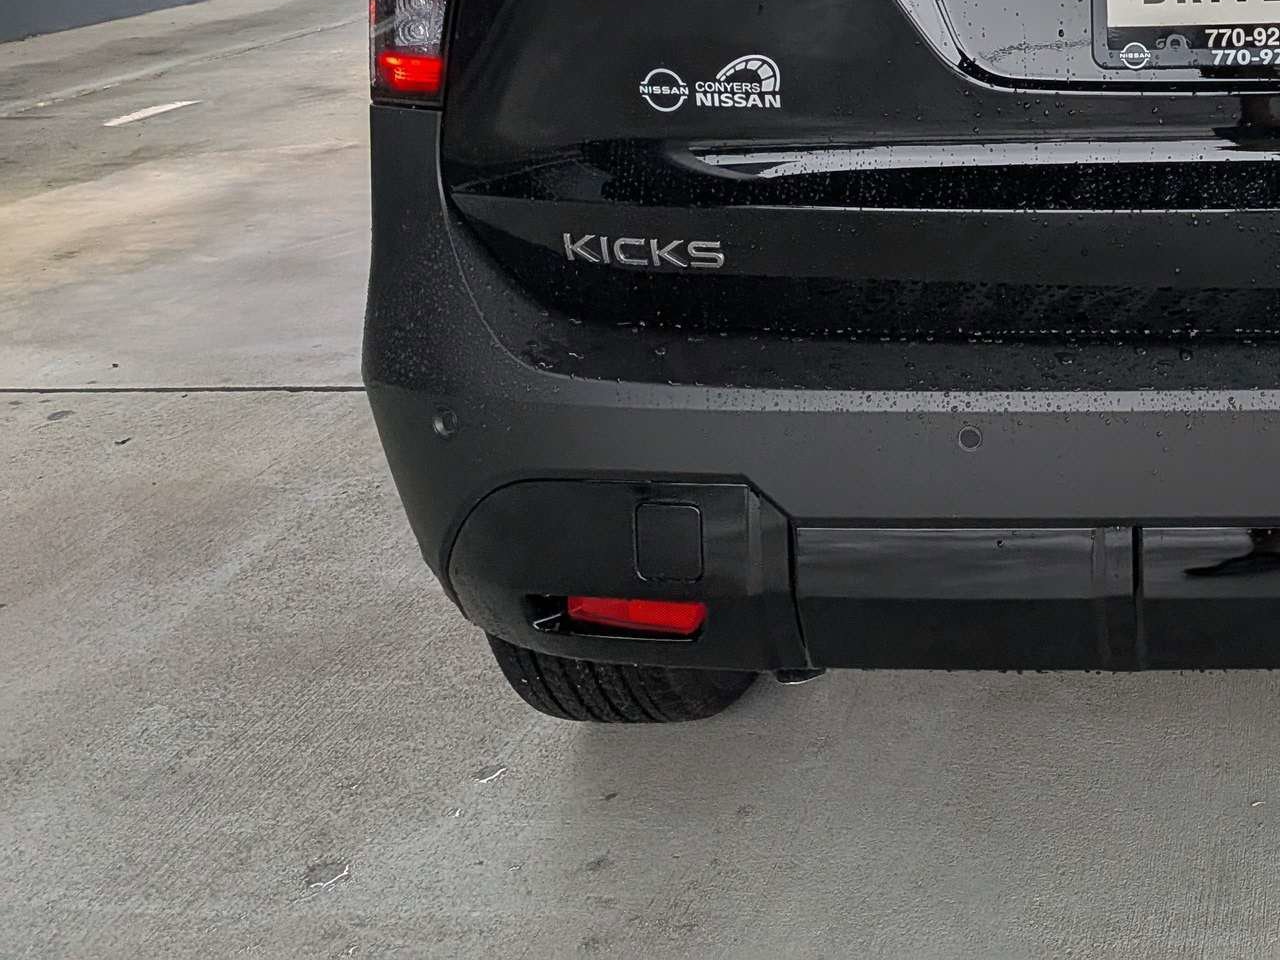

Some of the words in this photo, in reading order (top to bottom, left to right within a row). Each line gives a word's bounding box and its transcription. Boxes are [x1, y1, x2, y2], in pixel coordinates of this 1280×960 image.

[639, 85, 689, 96] NISSAN
[695, 81, 761, 93] CONYERS
[695, 92, 782, 109] NISSAN
[563, 232, 725, 269] KICKS
